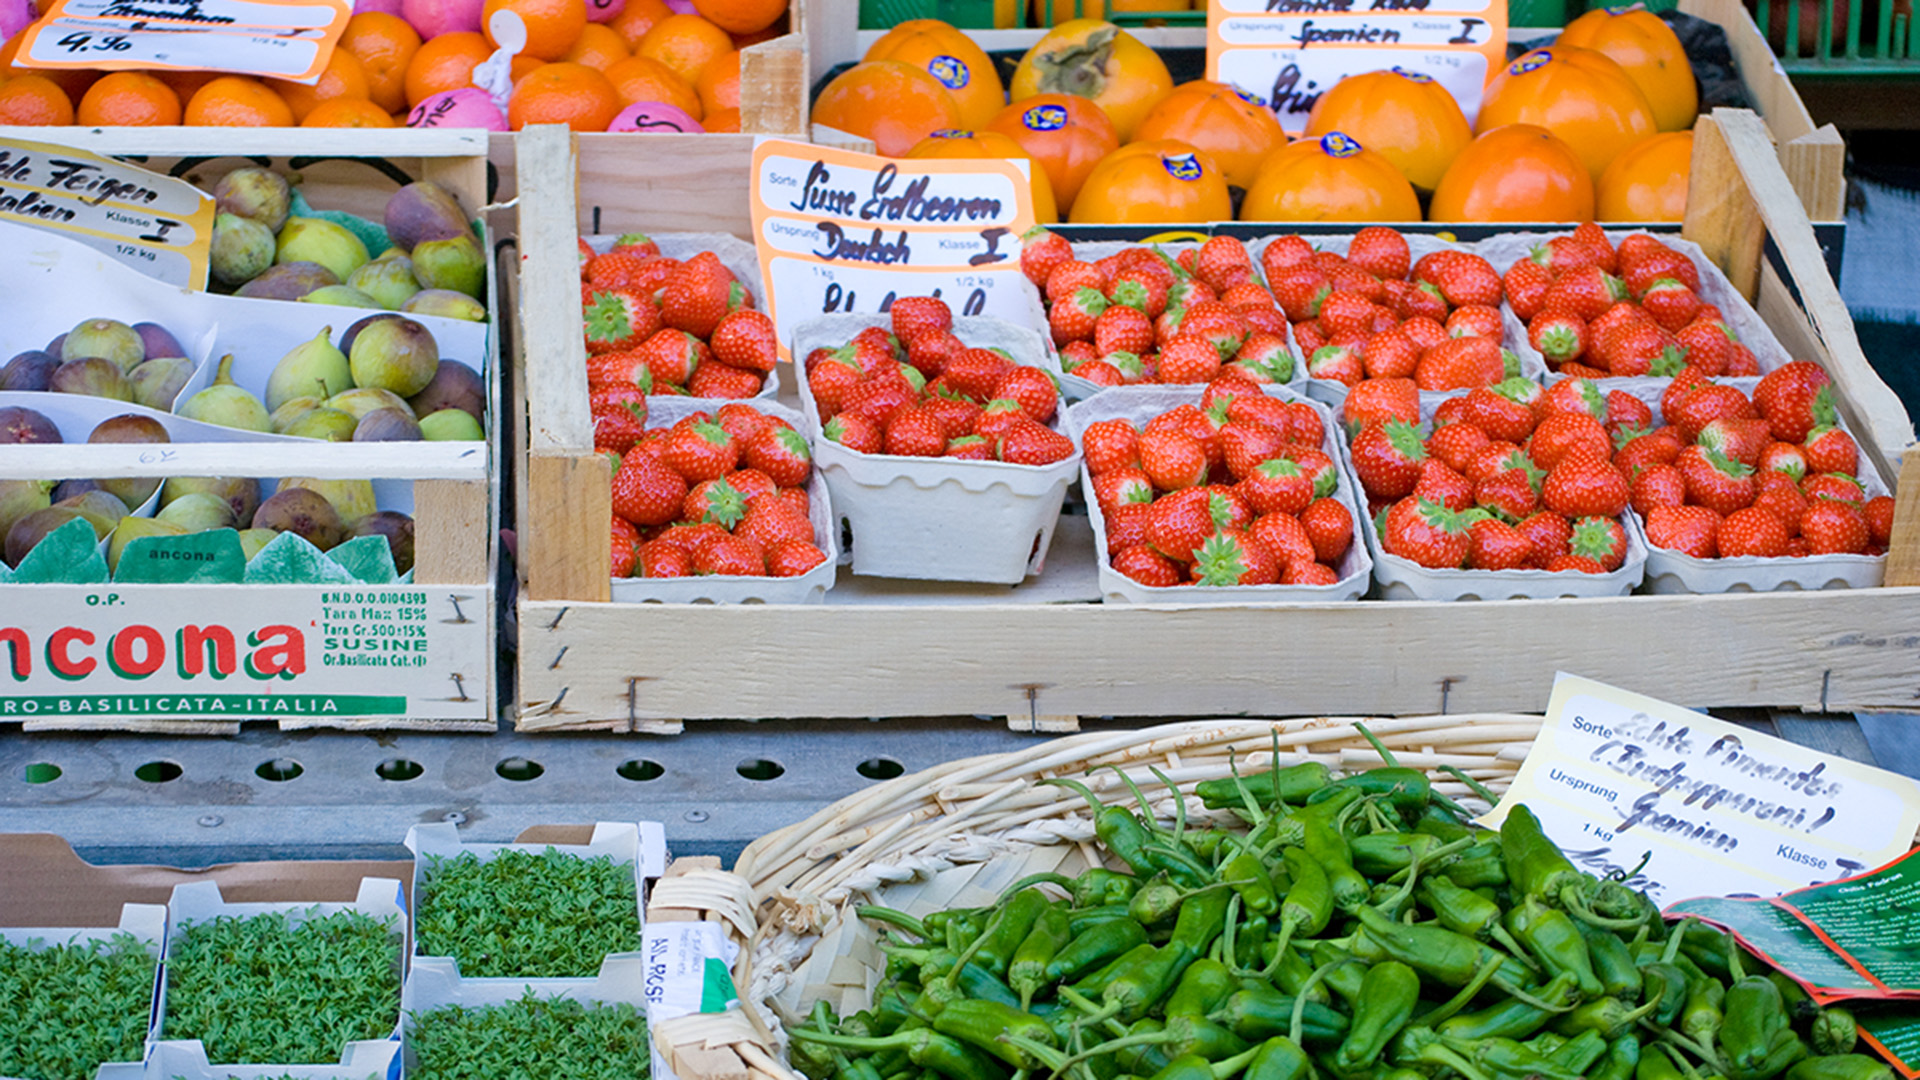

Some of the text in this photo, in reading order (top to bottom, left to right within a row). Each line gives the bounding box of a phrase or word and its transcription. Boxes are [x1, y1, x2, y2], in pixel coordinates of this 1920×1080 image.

[1291, 20, 1401, 49] Spanien
[1448, 19, 1485, 44] I
[47, 159, 157, 206] Feigen
[769, 171, 798, 188] Sorte
[106, 211, 151, 228] Klasse
[139, 218, 182, 243] I
[116, 244, 157, 262] 1/2 kg
[770, 221, 821, 242] Ursprung
[937, 239, 981, 251] Klasse
[968, 226, 1011, 267] I
[812, 265, 995, 290] 1 kg 1/2 kg
[148, 549, 216, 562] ancona
[85, 593, 126, 607] O.P.
[322, 606, 357, 621] Tara
[396, 607, 428, 621] 15%
[322, 622, 349, 636] Tara
[323, 637, 429, 652] SUSINE
[1572, 715, 1614, 740] Sorte
[1549, 767, 1618, 802] Ursprung
[1777, 844, 1828, 870] Klasse
[1594, 827, 1614, 843] kg
